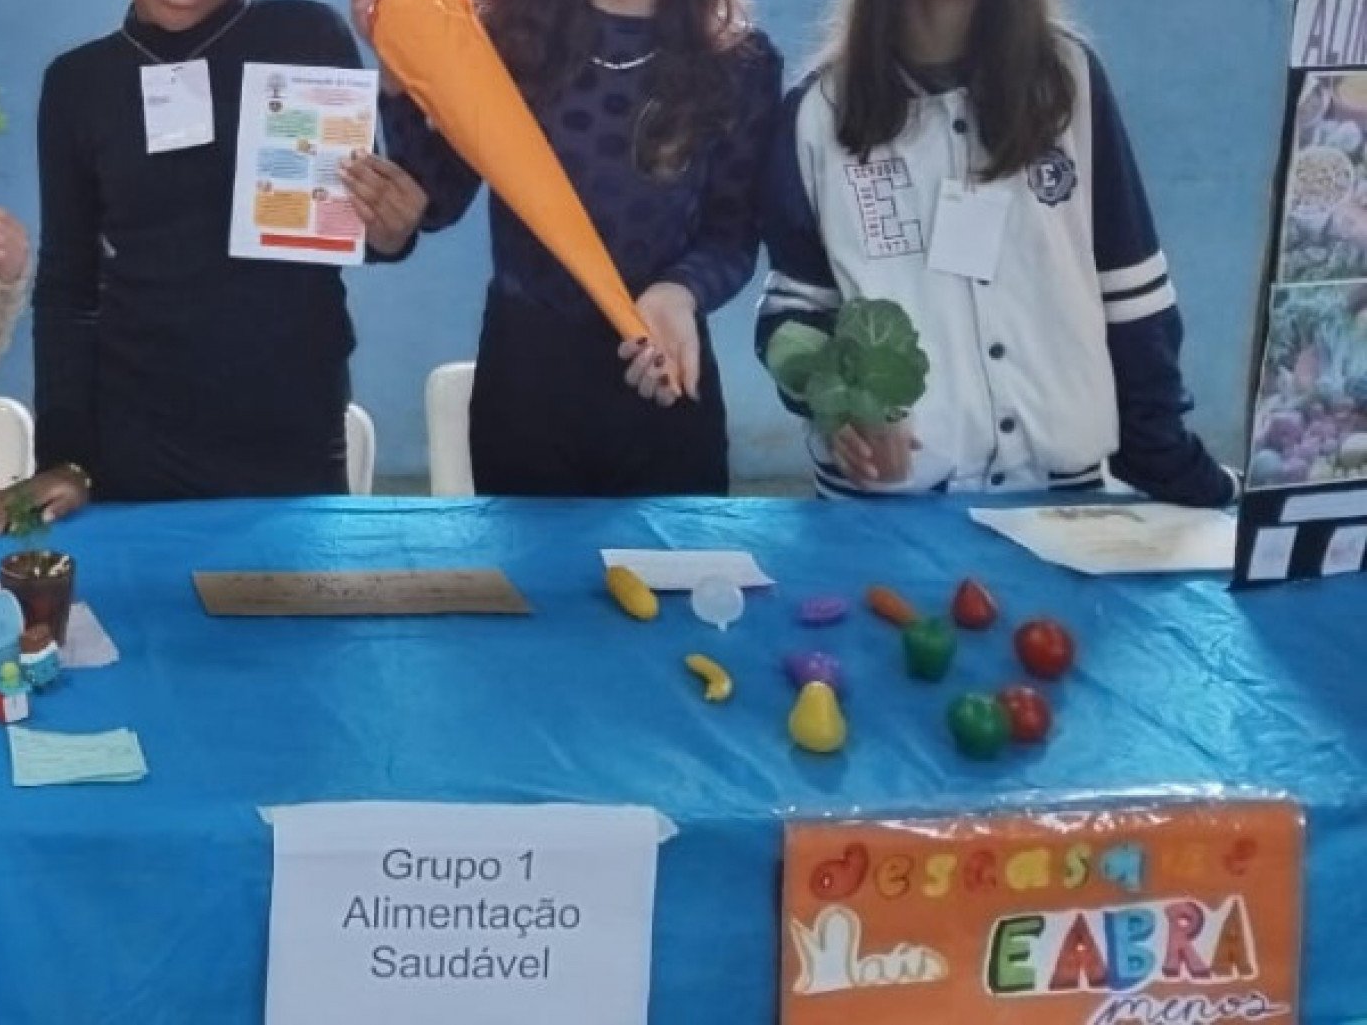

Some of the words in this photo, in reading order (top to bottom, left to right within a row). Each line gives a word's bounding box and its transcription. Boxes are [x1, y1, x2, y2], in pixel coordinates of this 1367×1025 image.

[383, 848, 502, 888] Grupo
[517, 849, 534, 881] 1
[342, 895, 581, 939] Alimentação
[371, 945, 550, 978] Saudável
